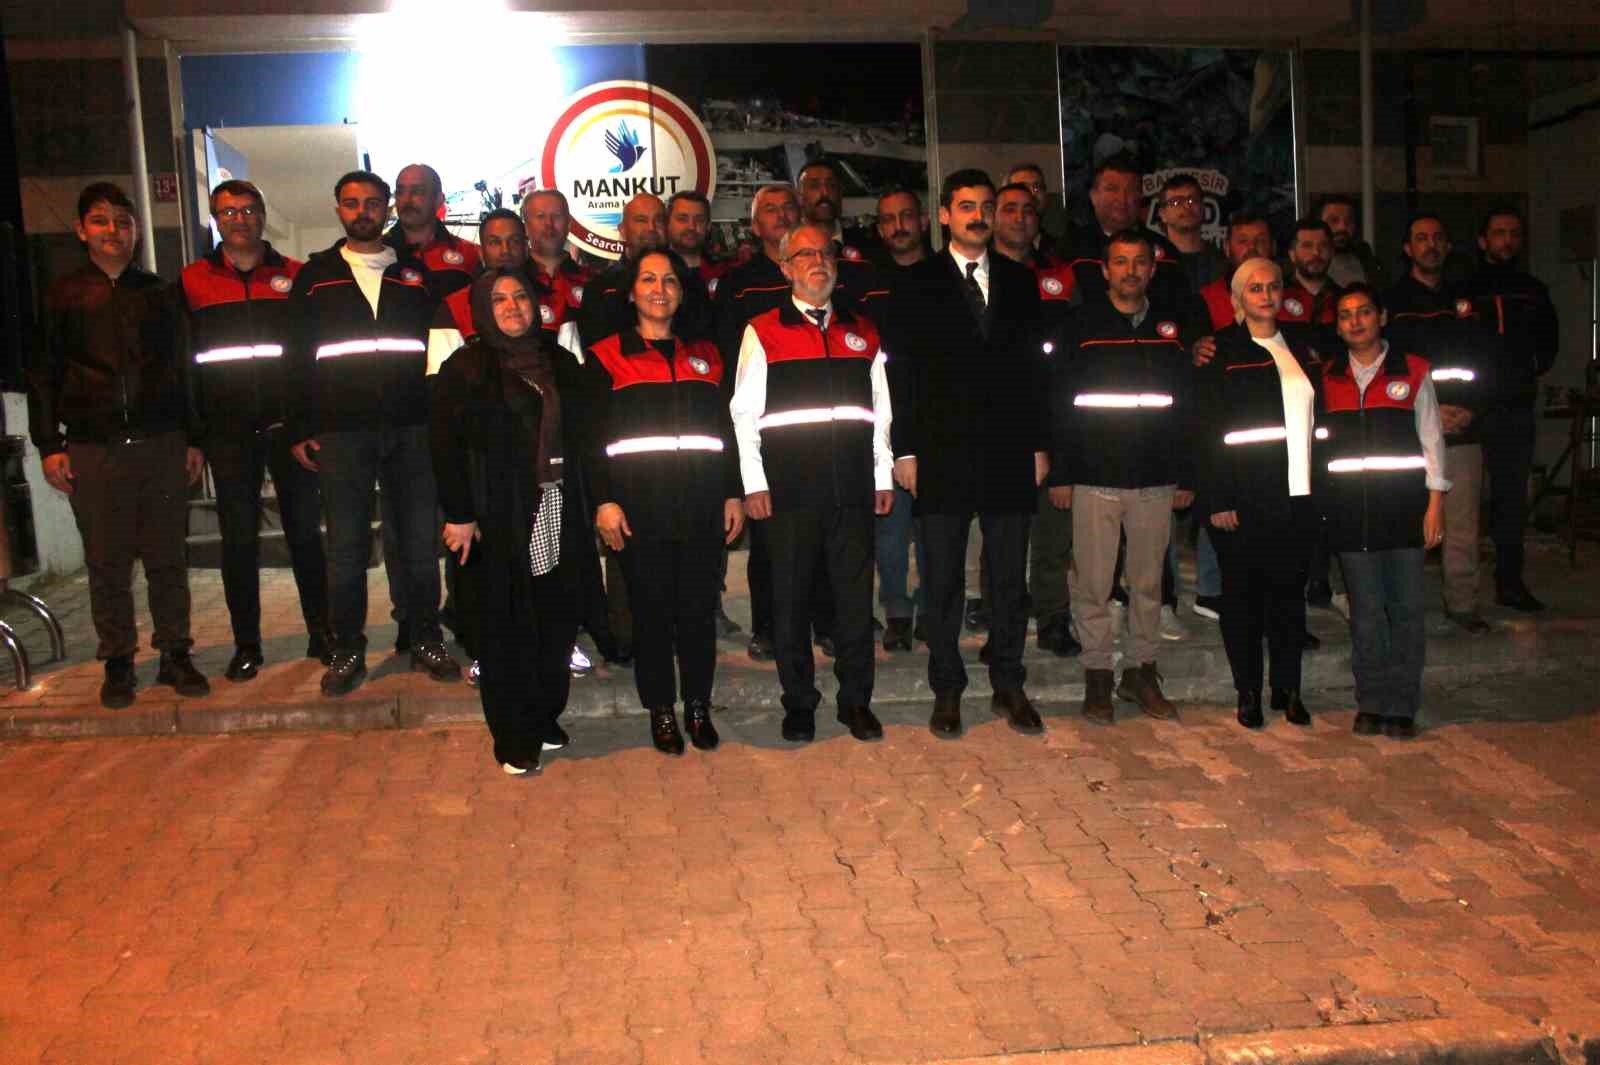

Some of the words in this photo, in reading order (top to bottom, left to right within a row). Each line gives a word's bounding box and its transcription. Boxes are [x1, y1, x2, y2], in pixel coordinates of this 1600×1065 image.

[573, 176, 681, 198] MANKUT
[588, 200, 620, 208] Arama
[585, 232, 624, 252] Search
